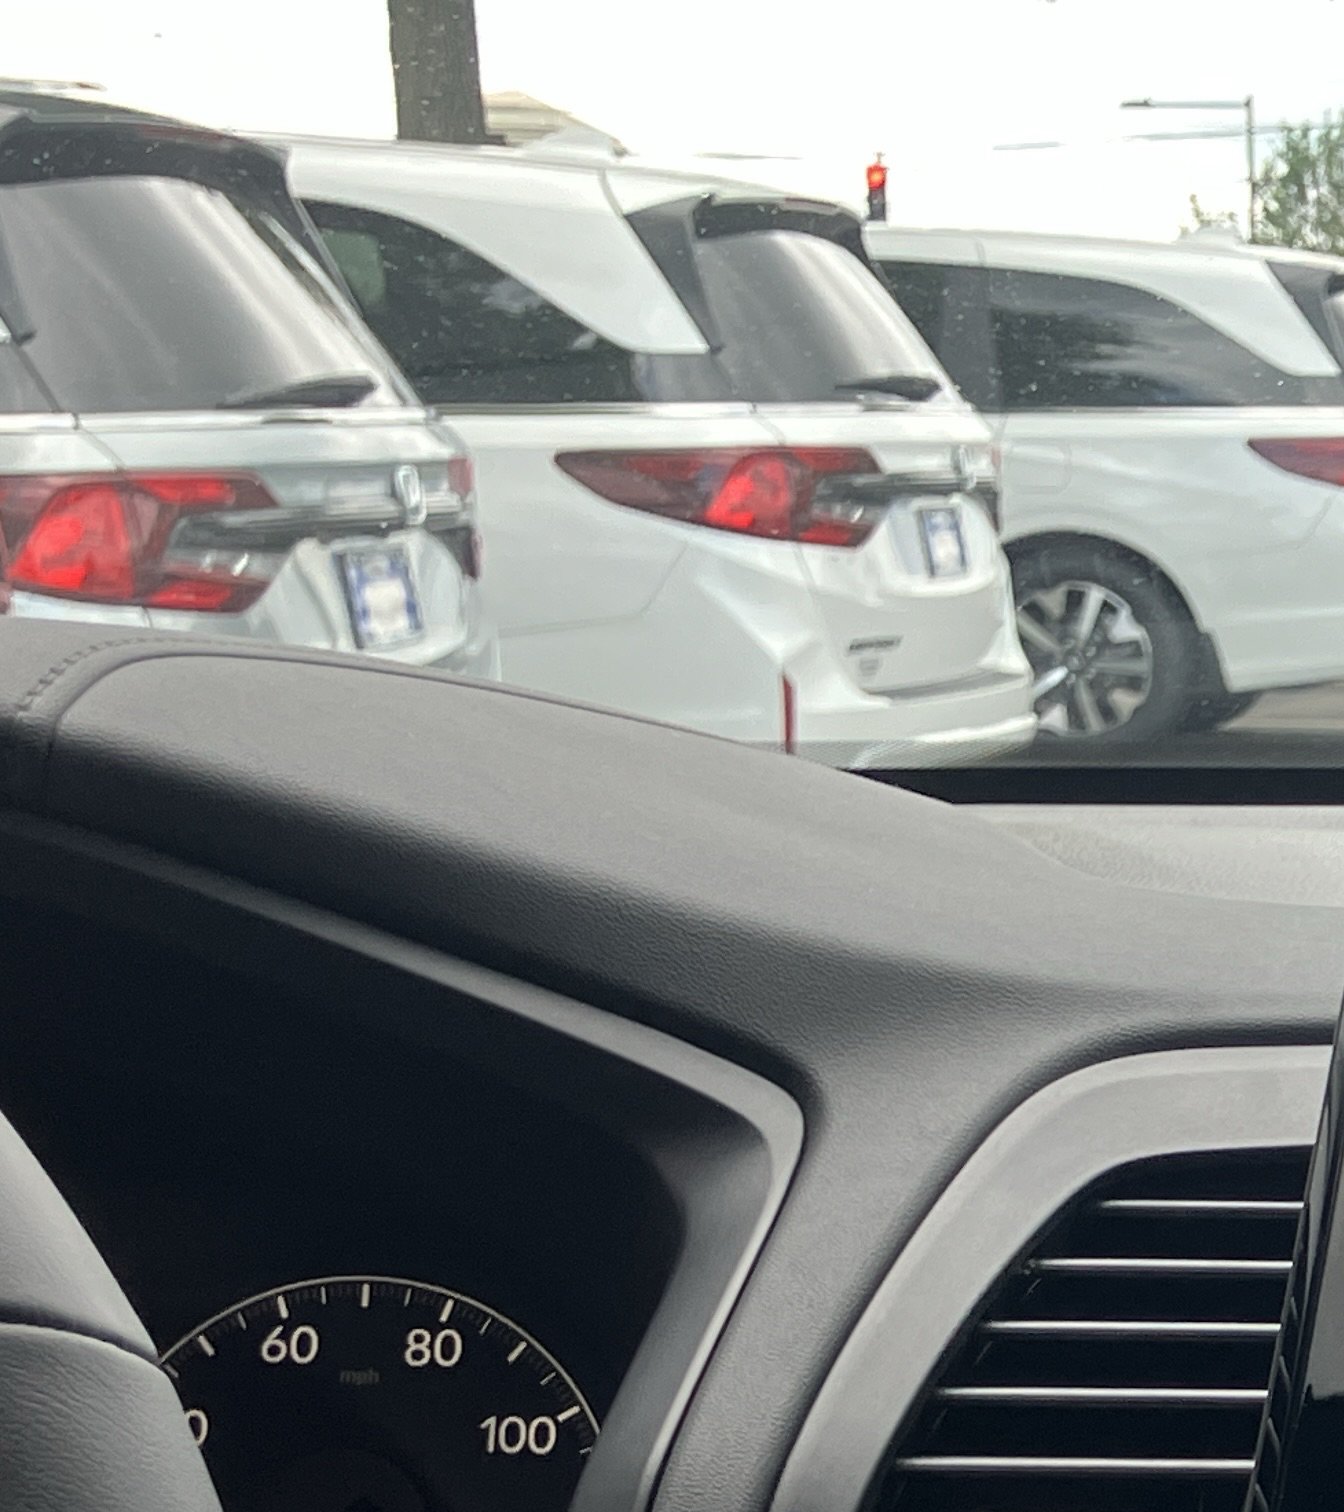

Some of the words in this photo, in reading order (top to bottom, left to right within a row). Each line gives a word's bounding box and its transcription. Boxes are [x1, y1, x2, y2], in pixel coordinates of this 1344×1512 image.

[261, 1325, 319, 1364] 60
[404, 1328, 462, 1367] 80
[339, 1367, 380, 1386] mph
[183, 1408, 209, 1448] 0
[480, 1415, 557, 1455] 100
